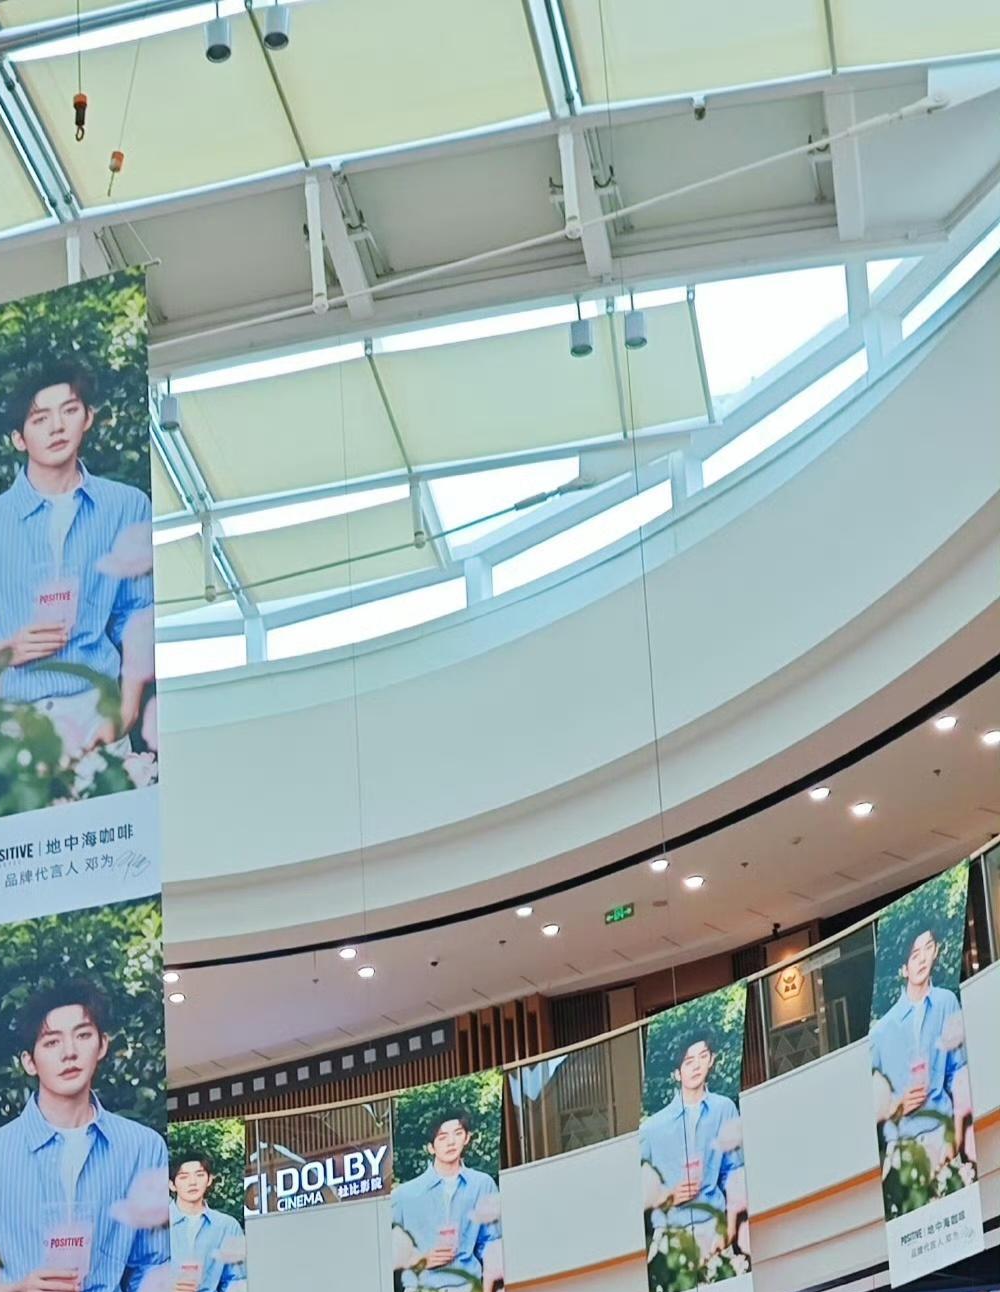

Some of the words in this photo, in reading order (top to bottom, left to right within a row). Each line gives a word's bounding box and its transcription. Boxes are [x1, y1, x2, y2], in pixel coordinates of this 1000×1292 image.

[40, 591, 71, 604] POSITIVE
[46, 824, 135, 855] 地中海咖啡
[5, 861, 79, 888] 品牌代言人
[85, 854, 114, 872] 邓为
[276, 1145, 388, 1197] DOLBY
[277, 1191, 324, 1212] CINEMA
[50, 1237, 85, 1248] POSITIVE
